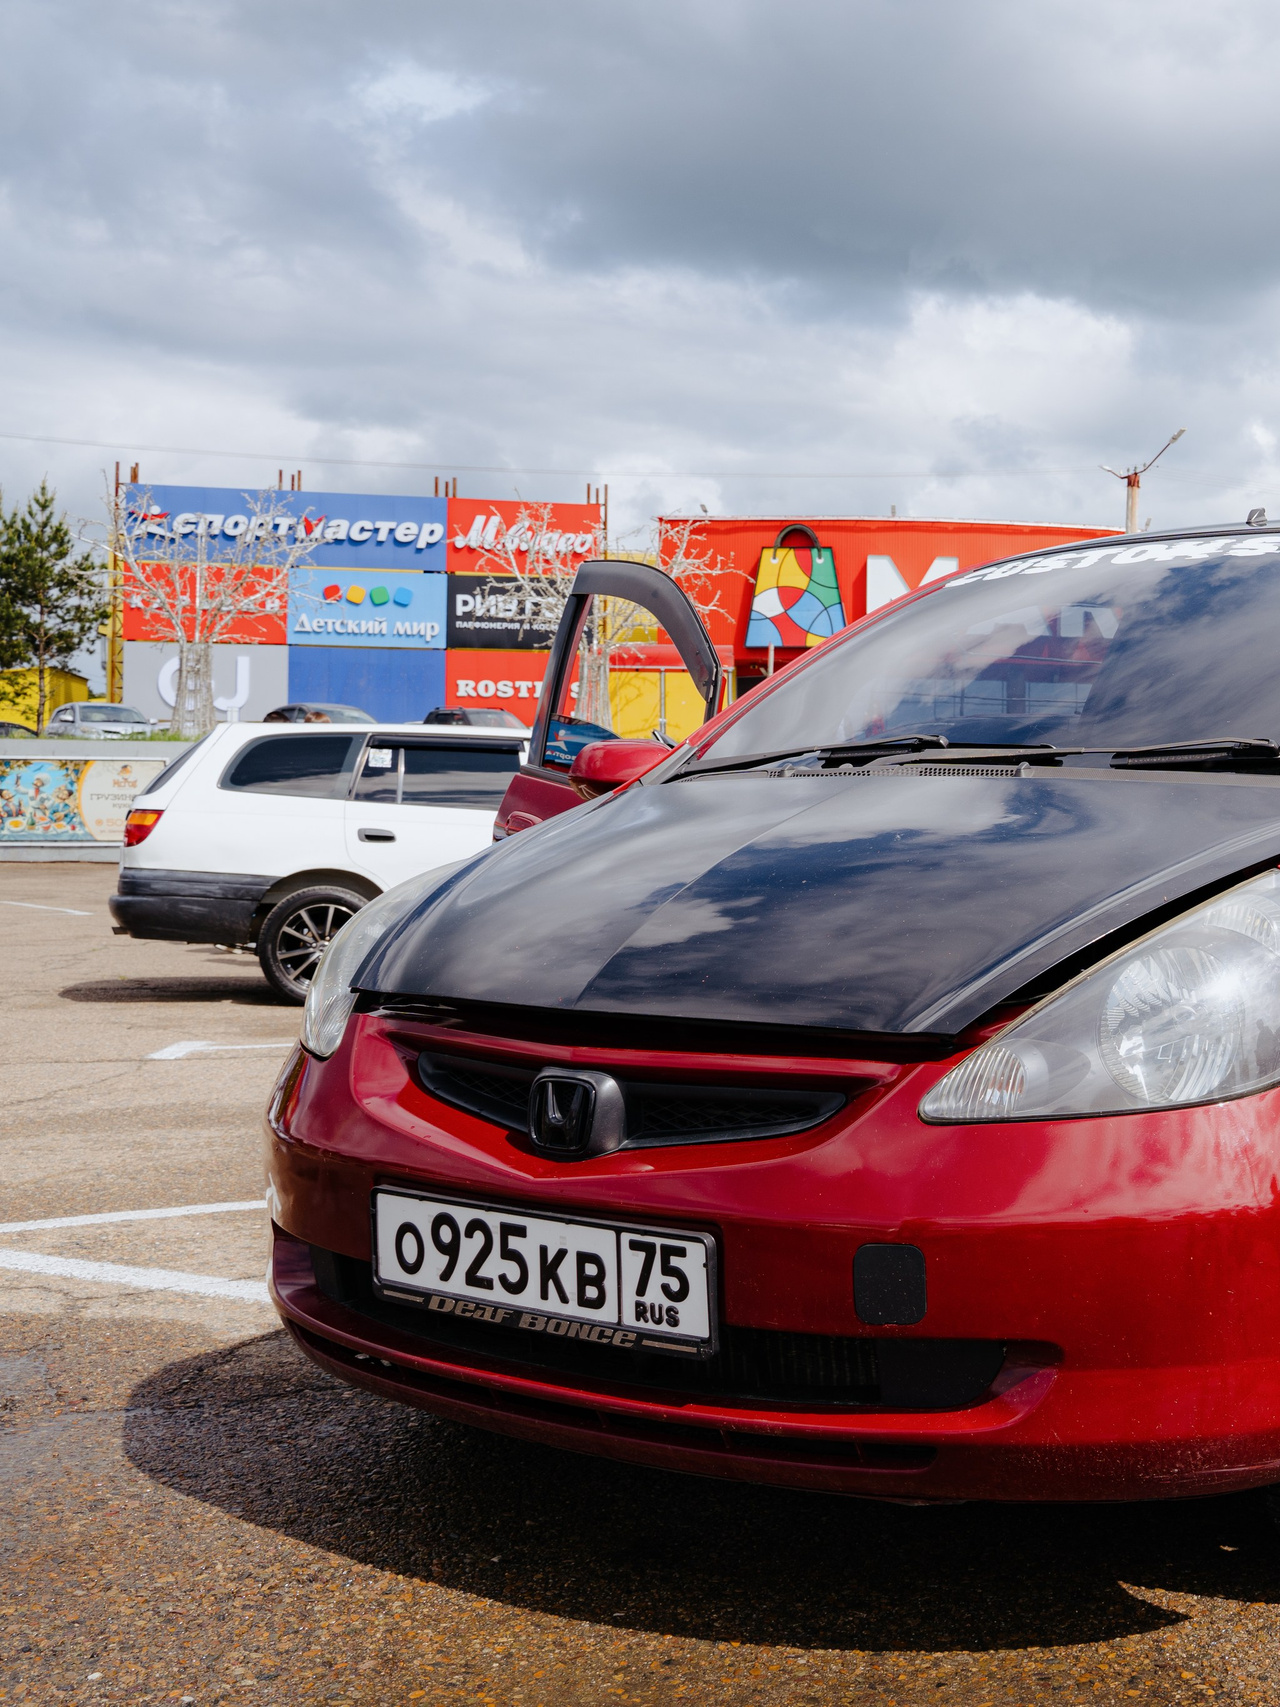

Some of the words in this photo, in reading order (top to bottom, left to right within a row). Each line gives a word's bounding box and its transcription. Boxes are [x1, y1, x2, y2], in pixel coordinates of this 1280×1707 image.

[294, 613, 388, 636] Детский
[393, 621, 440, 642] мир
[629, 1239, 690, 1303] 75
[635, 1300, 681, 1328] RUS
